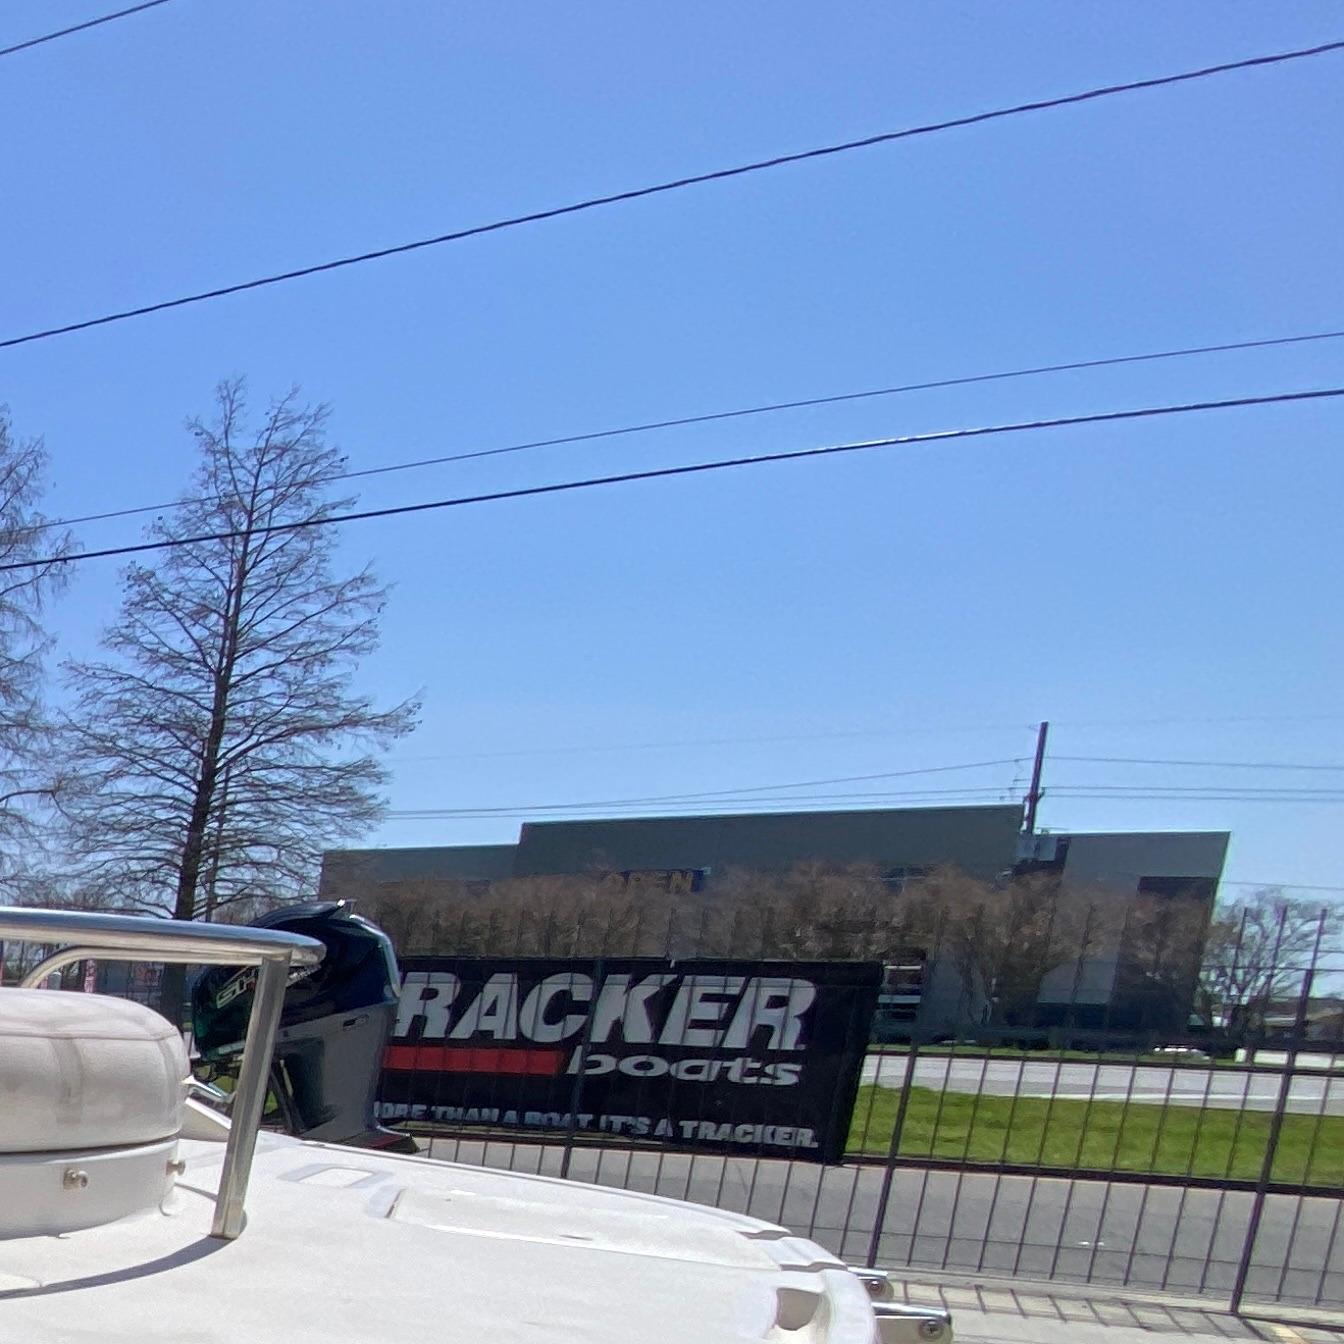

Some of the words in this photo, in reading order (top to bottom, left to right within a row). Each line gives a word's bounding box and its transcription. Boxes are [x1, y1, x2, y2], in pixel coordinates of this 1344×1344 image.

[393, 971, 816, 1051] RACKER
[565, 1045, 802, 1086] boats
[430, 1106, 500, 1123] THAN
[503, 1110, 519, 1124] A
[524, 1111, 593, 1128] BOAT
[654, 1118, 674, 1137] A
